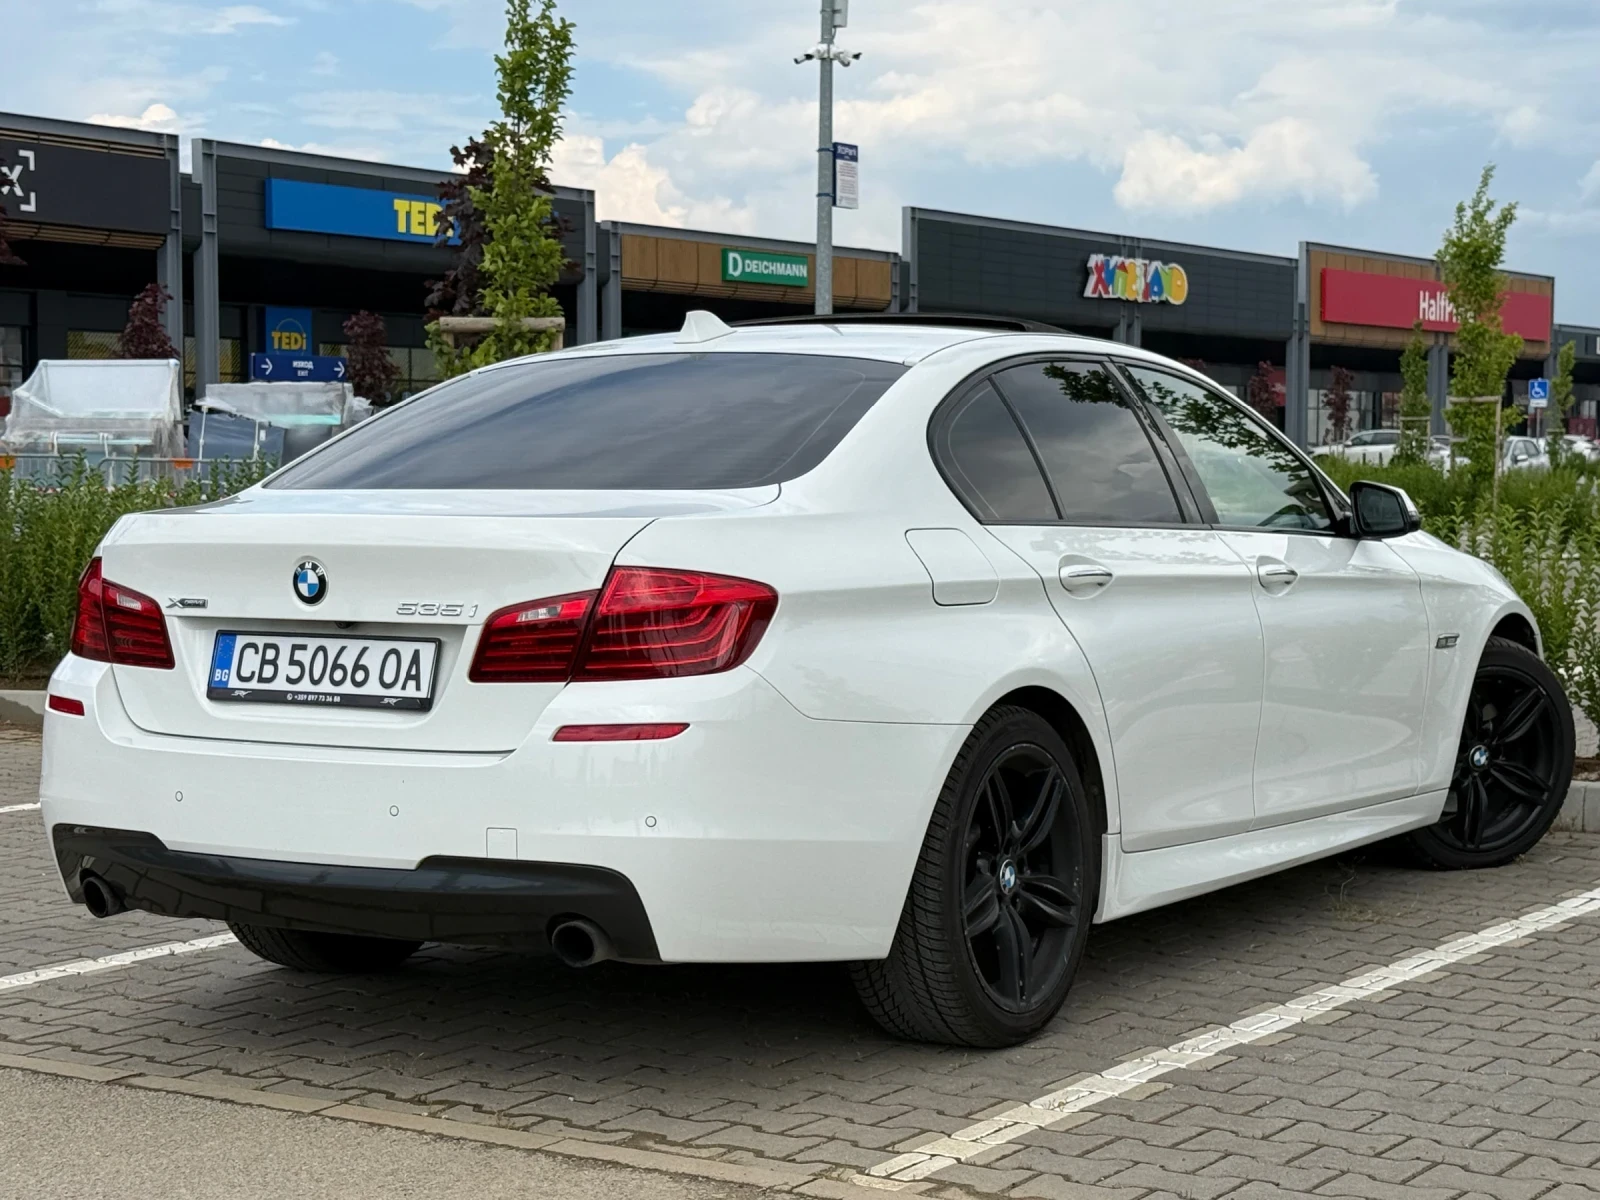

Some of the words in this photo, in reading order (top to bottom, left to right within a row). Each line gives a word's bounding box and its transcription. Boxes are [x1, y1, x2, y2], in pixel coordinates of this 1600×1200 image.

[744, 260, 807, 277] DEICHMANN
[271, 331, 306, 350] TEDi
[236, 642, 281, 684] CB
[285, 644, 370, 689] 5066
[214, 669, 230, 682] BG
